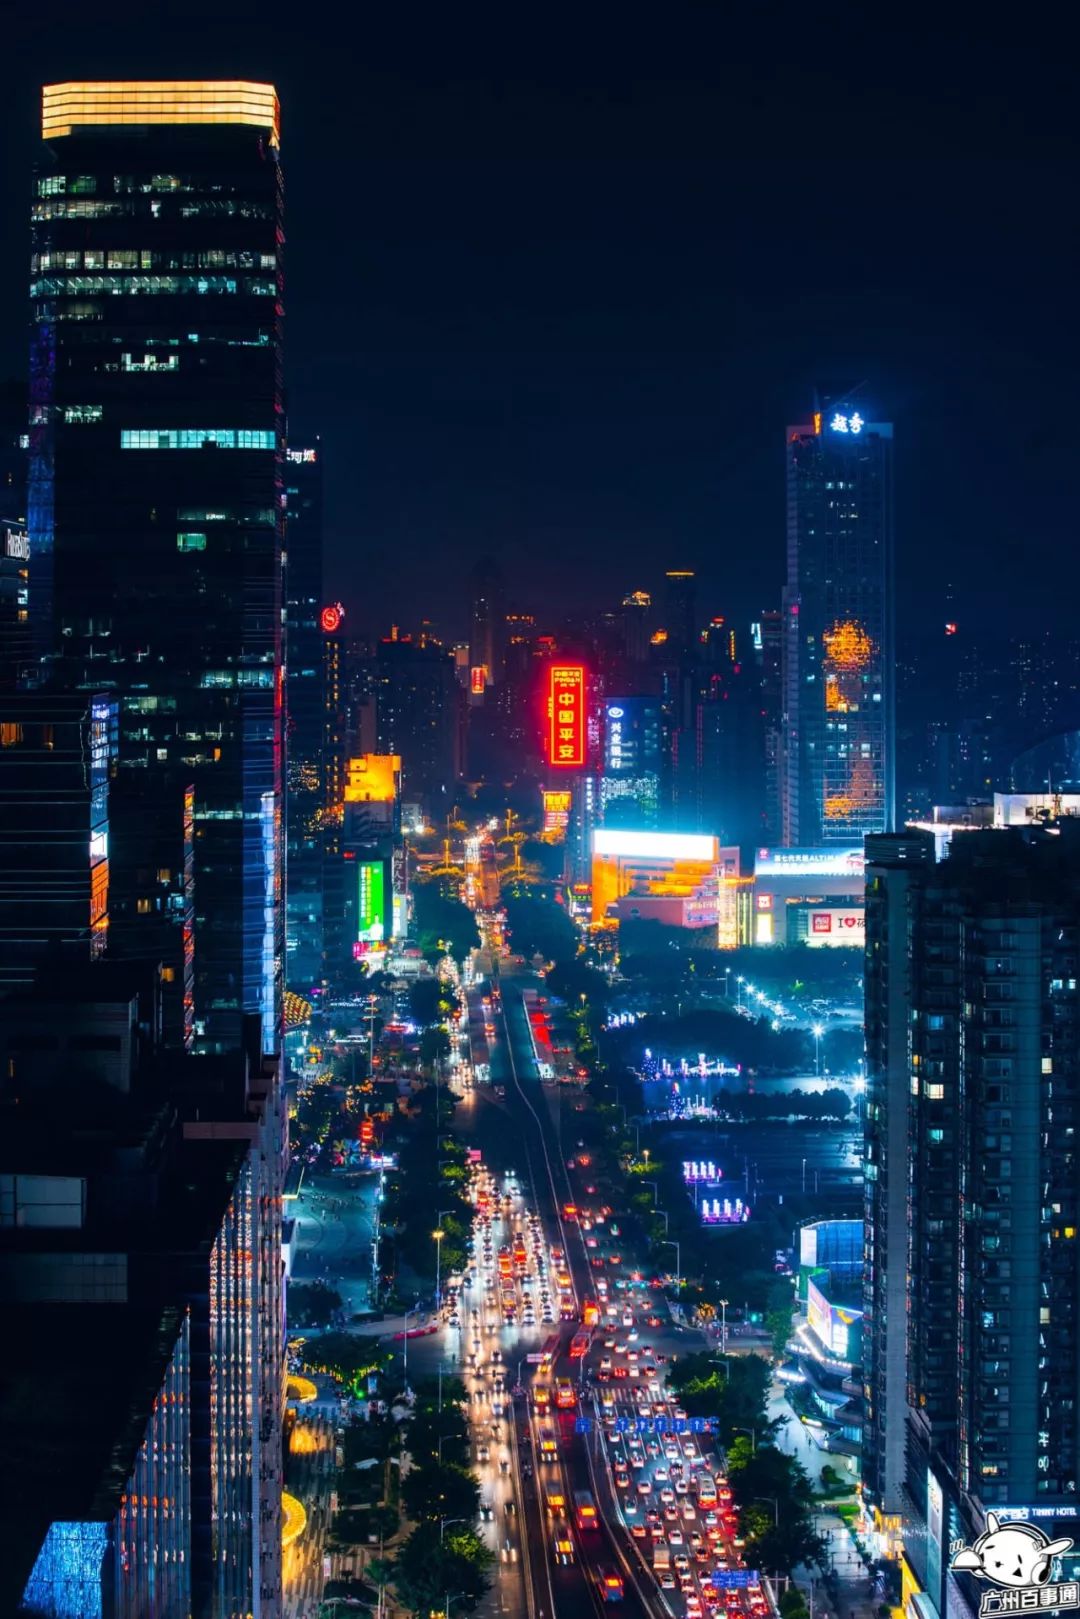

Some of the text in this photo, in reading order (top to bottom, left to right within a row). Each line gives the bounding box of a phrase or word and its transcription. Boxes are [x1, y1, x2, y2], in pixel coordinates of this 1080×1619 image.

[559, 693, 575, 758] 中国平安
[610, 722, 622, 768] 兴业银行
[1056, 1507, 1077, 1516] HOTEL
